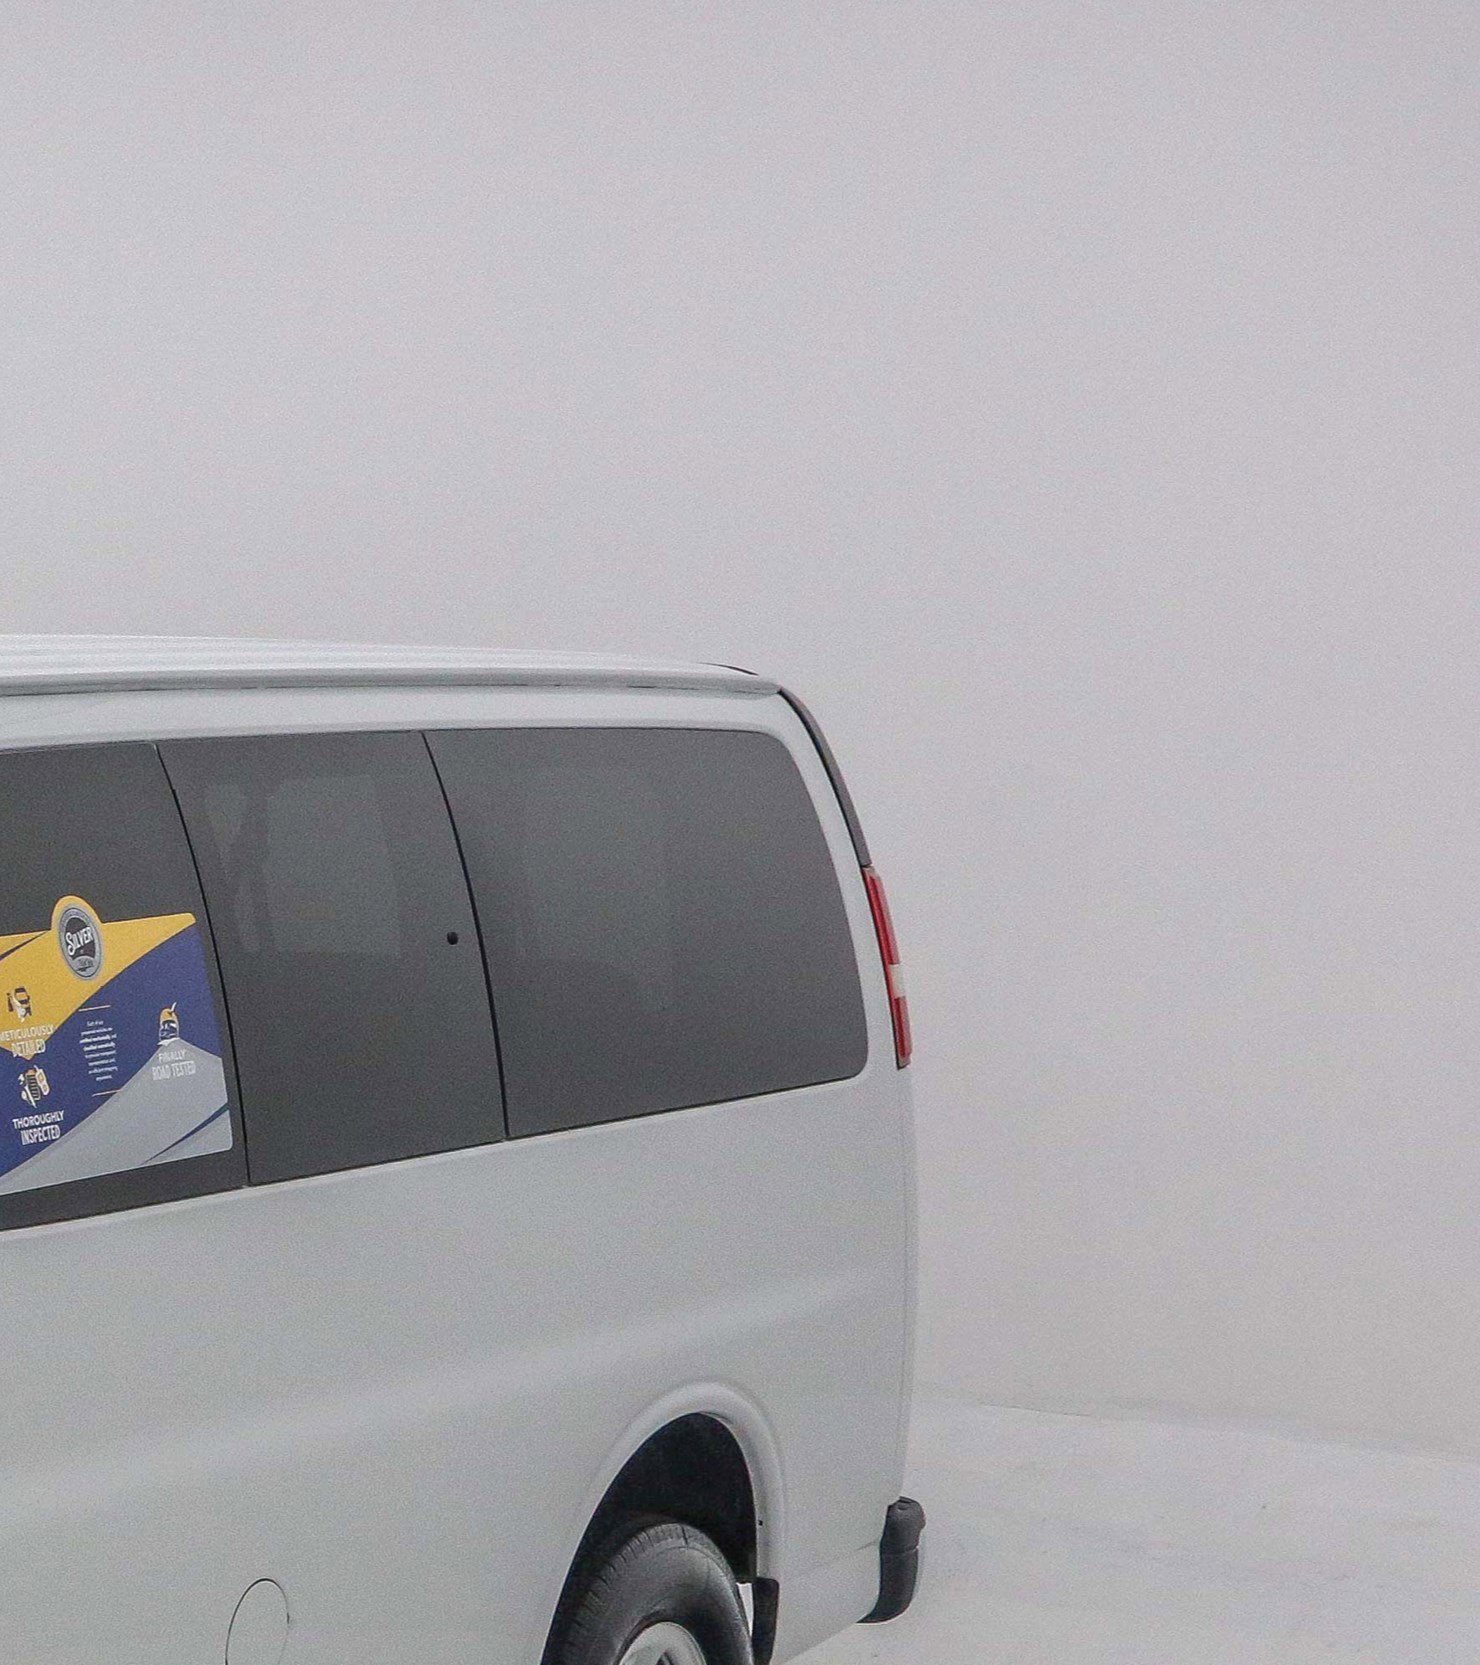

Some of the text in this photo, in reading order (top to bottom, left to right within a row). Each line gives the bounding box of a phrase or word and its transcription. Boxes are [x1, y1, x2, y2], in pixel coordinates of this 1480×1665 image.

[65, 926, 94, 956] SILVER
[11, 1038, 46, 1058] DETAILED
[158, 1049, 187, 1063] FINALLY
[152, 1060, 196, 1080] ROAD TESTED
[12, 1110, 65, 1130] THOROUGHLY
[20, 1124, 61, 1146] INSPECTED
